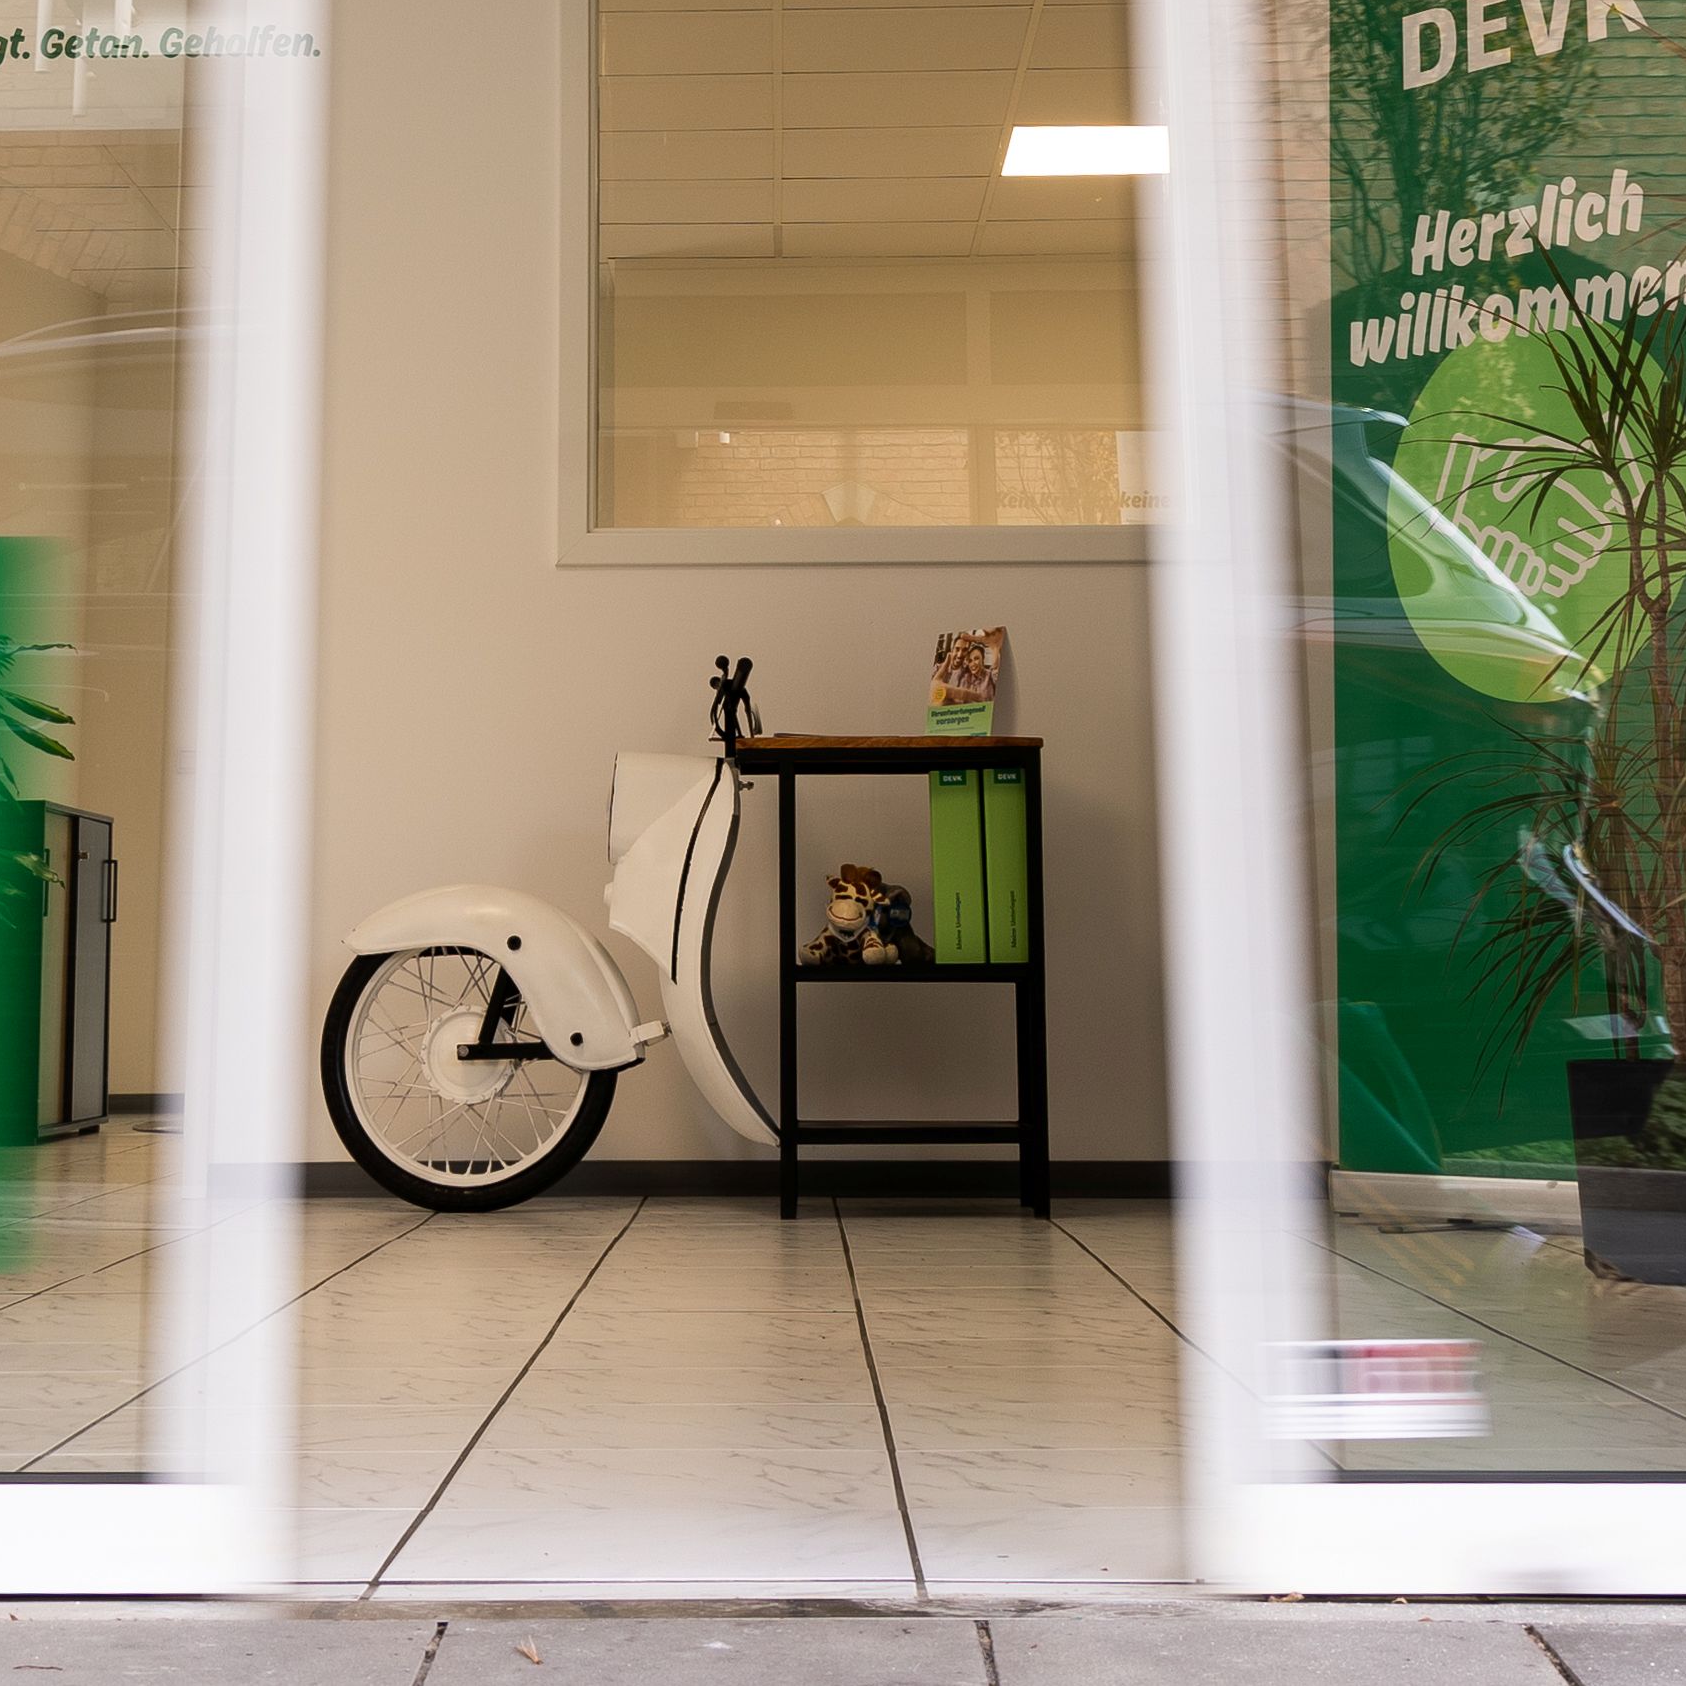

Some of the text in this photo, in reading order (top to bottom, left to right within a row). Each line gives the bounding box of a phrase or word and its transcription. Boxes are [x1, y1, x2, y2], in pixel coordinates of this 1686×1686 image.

[41, 27, 150, 60] Getan.
[159, 24, 321, 59] Geholfen.
[1411, 168, 1644, 276] Herzlich
